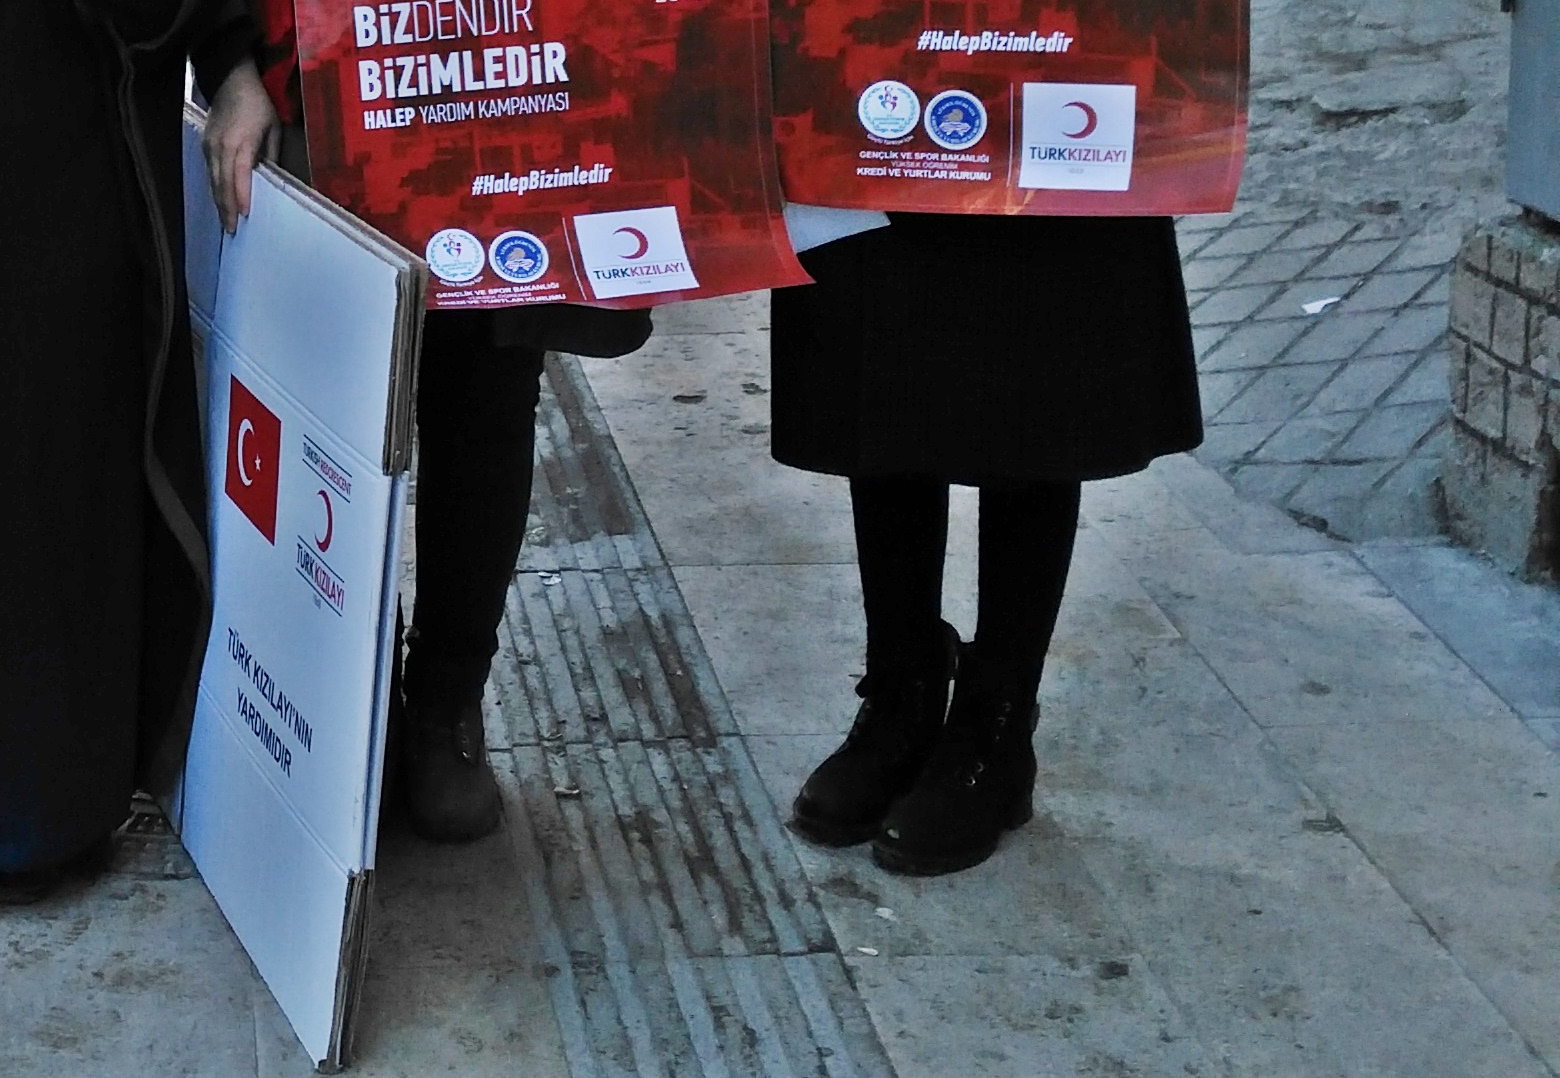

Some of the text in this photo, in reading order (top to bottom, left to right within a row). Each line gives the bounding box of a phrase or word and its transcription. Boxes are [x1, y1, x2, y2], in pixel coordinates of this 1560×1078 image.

[917, 31, 1074, 55] #HalepBizimledir
[363, 92, 570, 130] HALEP YARDIM KAMPANYASI
[900, 152, 913, 160] VE
[914, 152, 940, 161] SPOR
[471, 164, 613, 196] #HalepBizimledir
[888, 168, 901, 177] VE
[903, 169, 948, 179] YURTLAR
[949, 170, 991, 181] KURUMU
[314, 562, 345, 611] KIZILAYI
[227, 627, 253, 679] TÜRK
[237, 686, 293, 779] YARDIMIDIR
